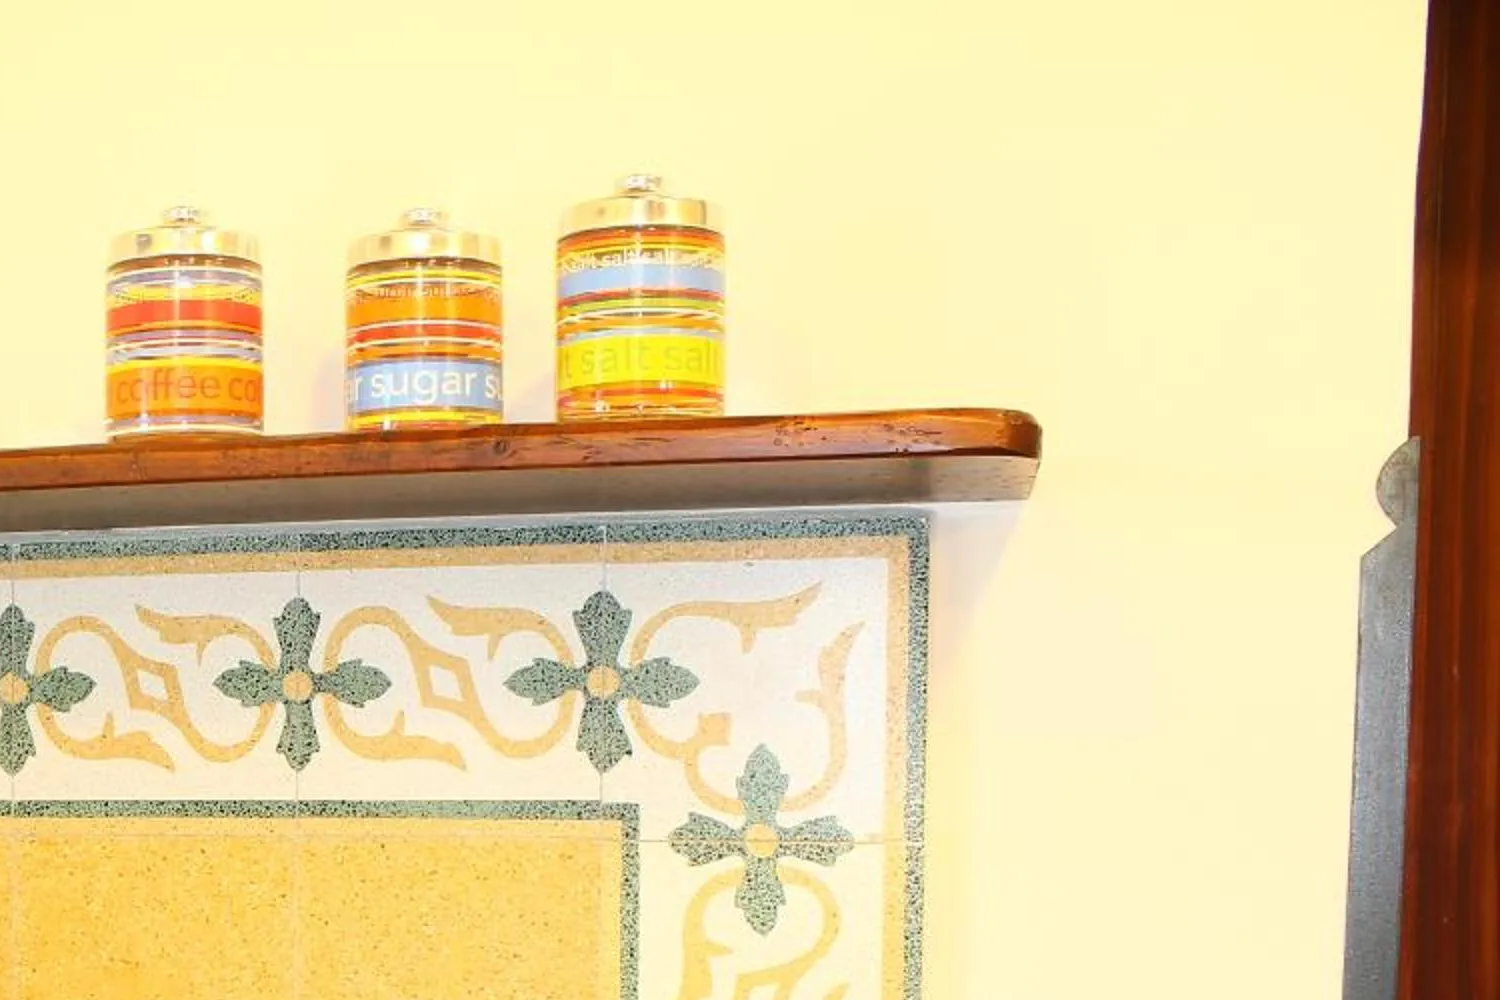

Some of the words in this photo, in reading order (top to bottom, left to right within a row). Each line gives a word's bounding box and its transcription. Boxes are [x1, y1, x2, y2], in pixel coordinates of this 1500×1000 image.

[580, 337, 651, 375] salt
[116, 369, 222, 404] coffee
[371, 369, 478, 404] sugar
